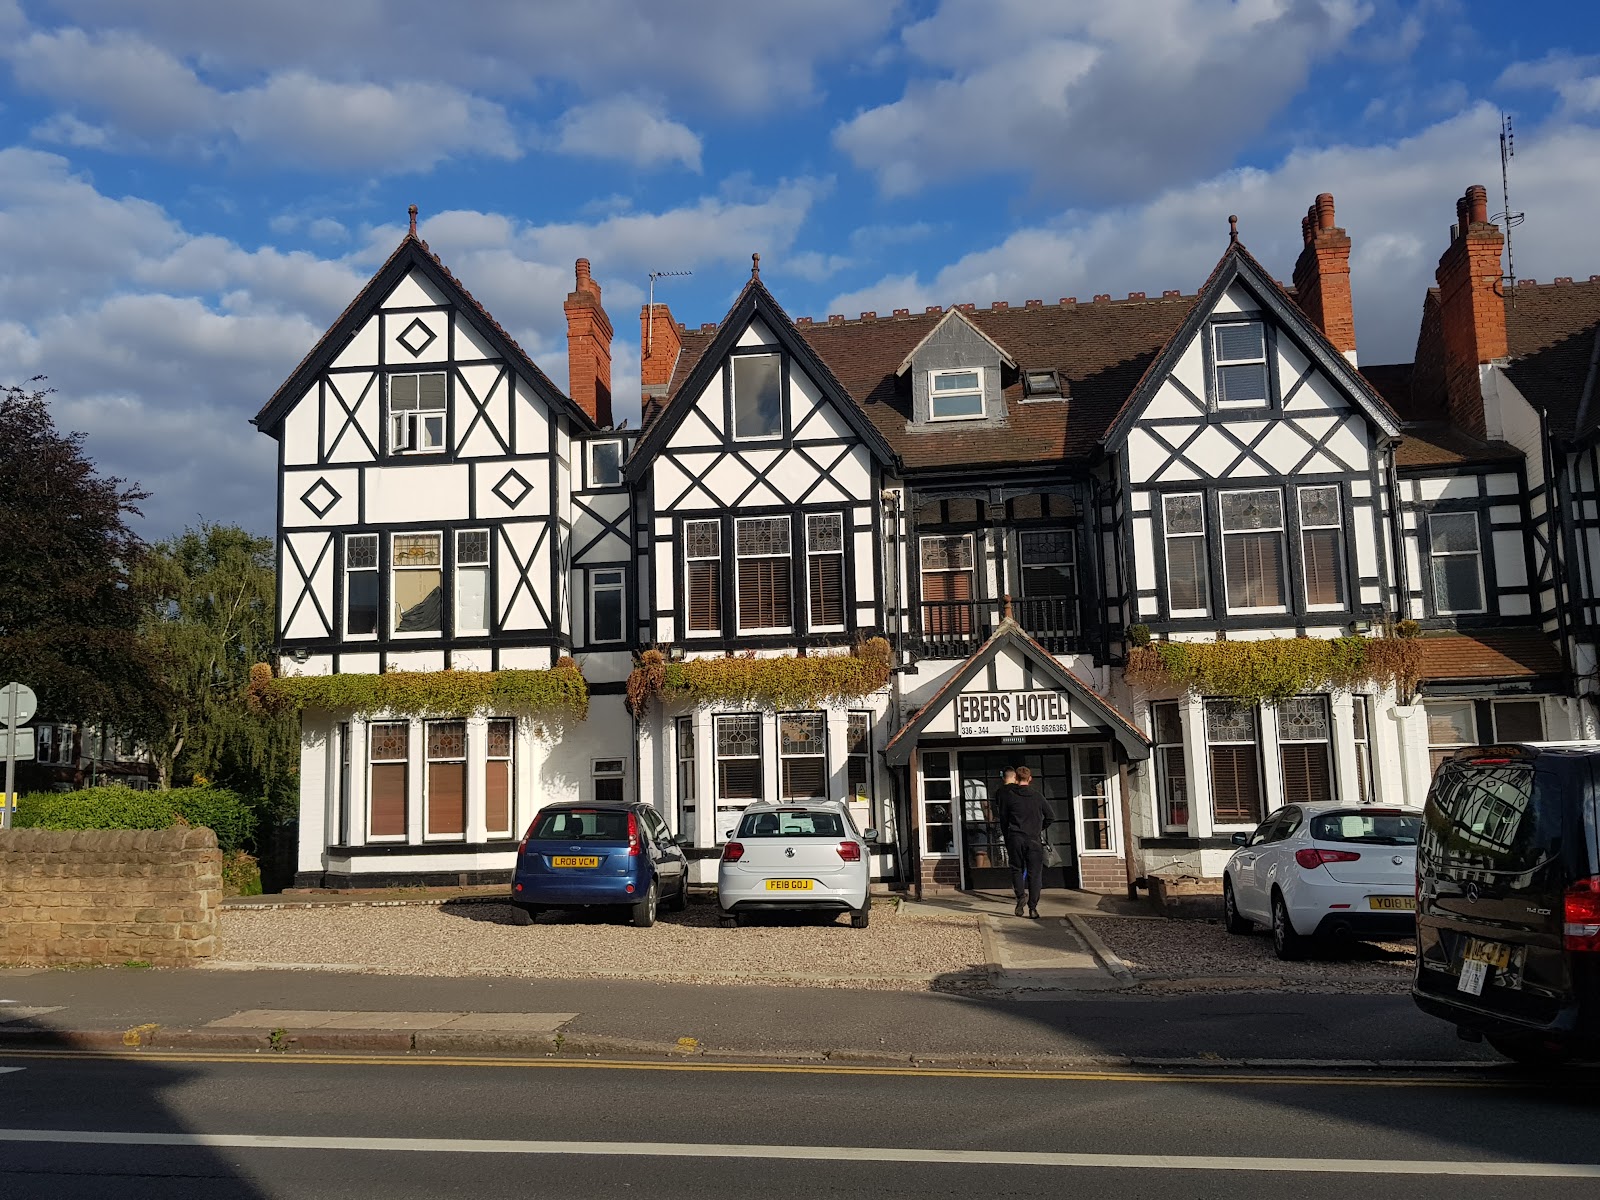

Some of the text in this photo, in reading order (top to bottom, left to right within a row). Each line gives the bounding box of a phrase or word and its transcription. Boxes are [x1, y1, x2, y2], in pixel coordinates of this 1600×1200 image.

[960, 694, 1067, 722] EBERS HOTEL
[961, 727, 973, 735] 336
[978, 726, 989, 734] 344
[1011, 725, 1024, 733] TEL:
[1025, 725, 1040, 733] 0115
[555, 857, 595, 866] LR08 VCM
[770, 880, 808, 889] FE18 GOJ
[1376, 898, 1402, 909] YO18
